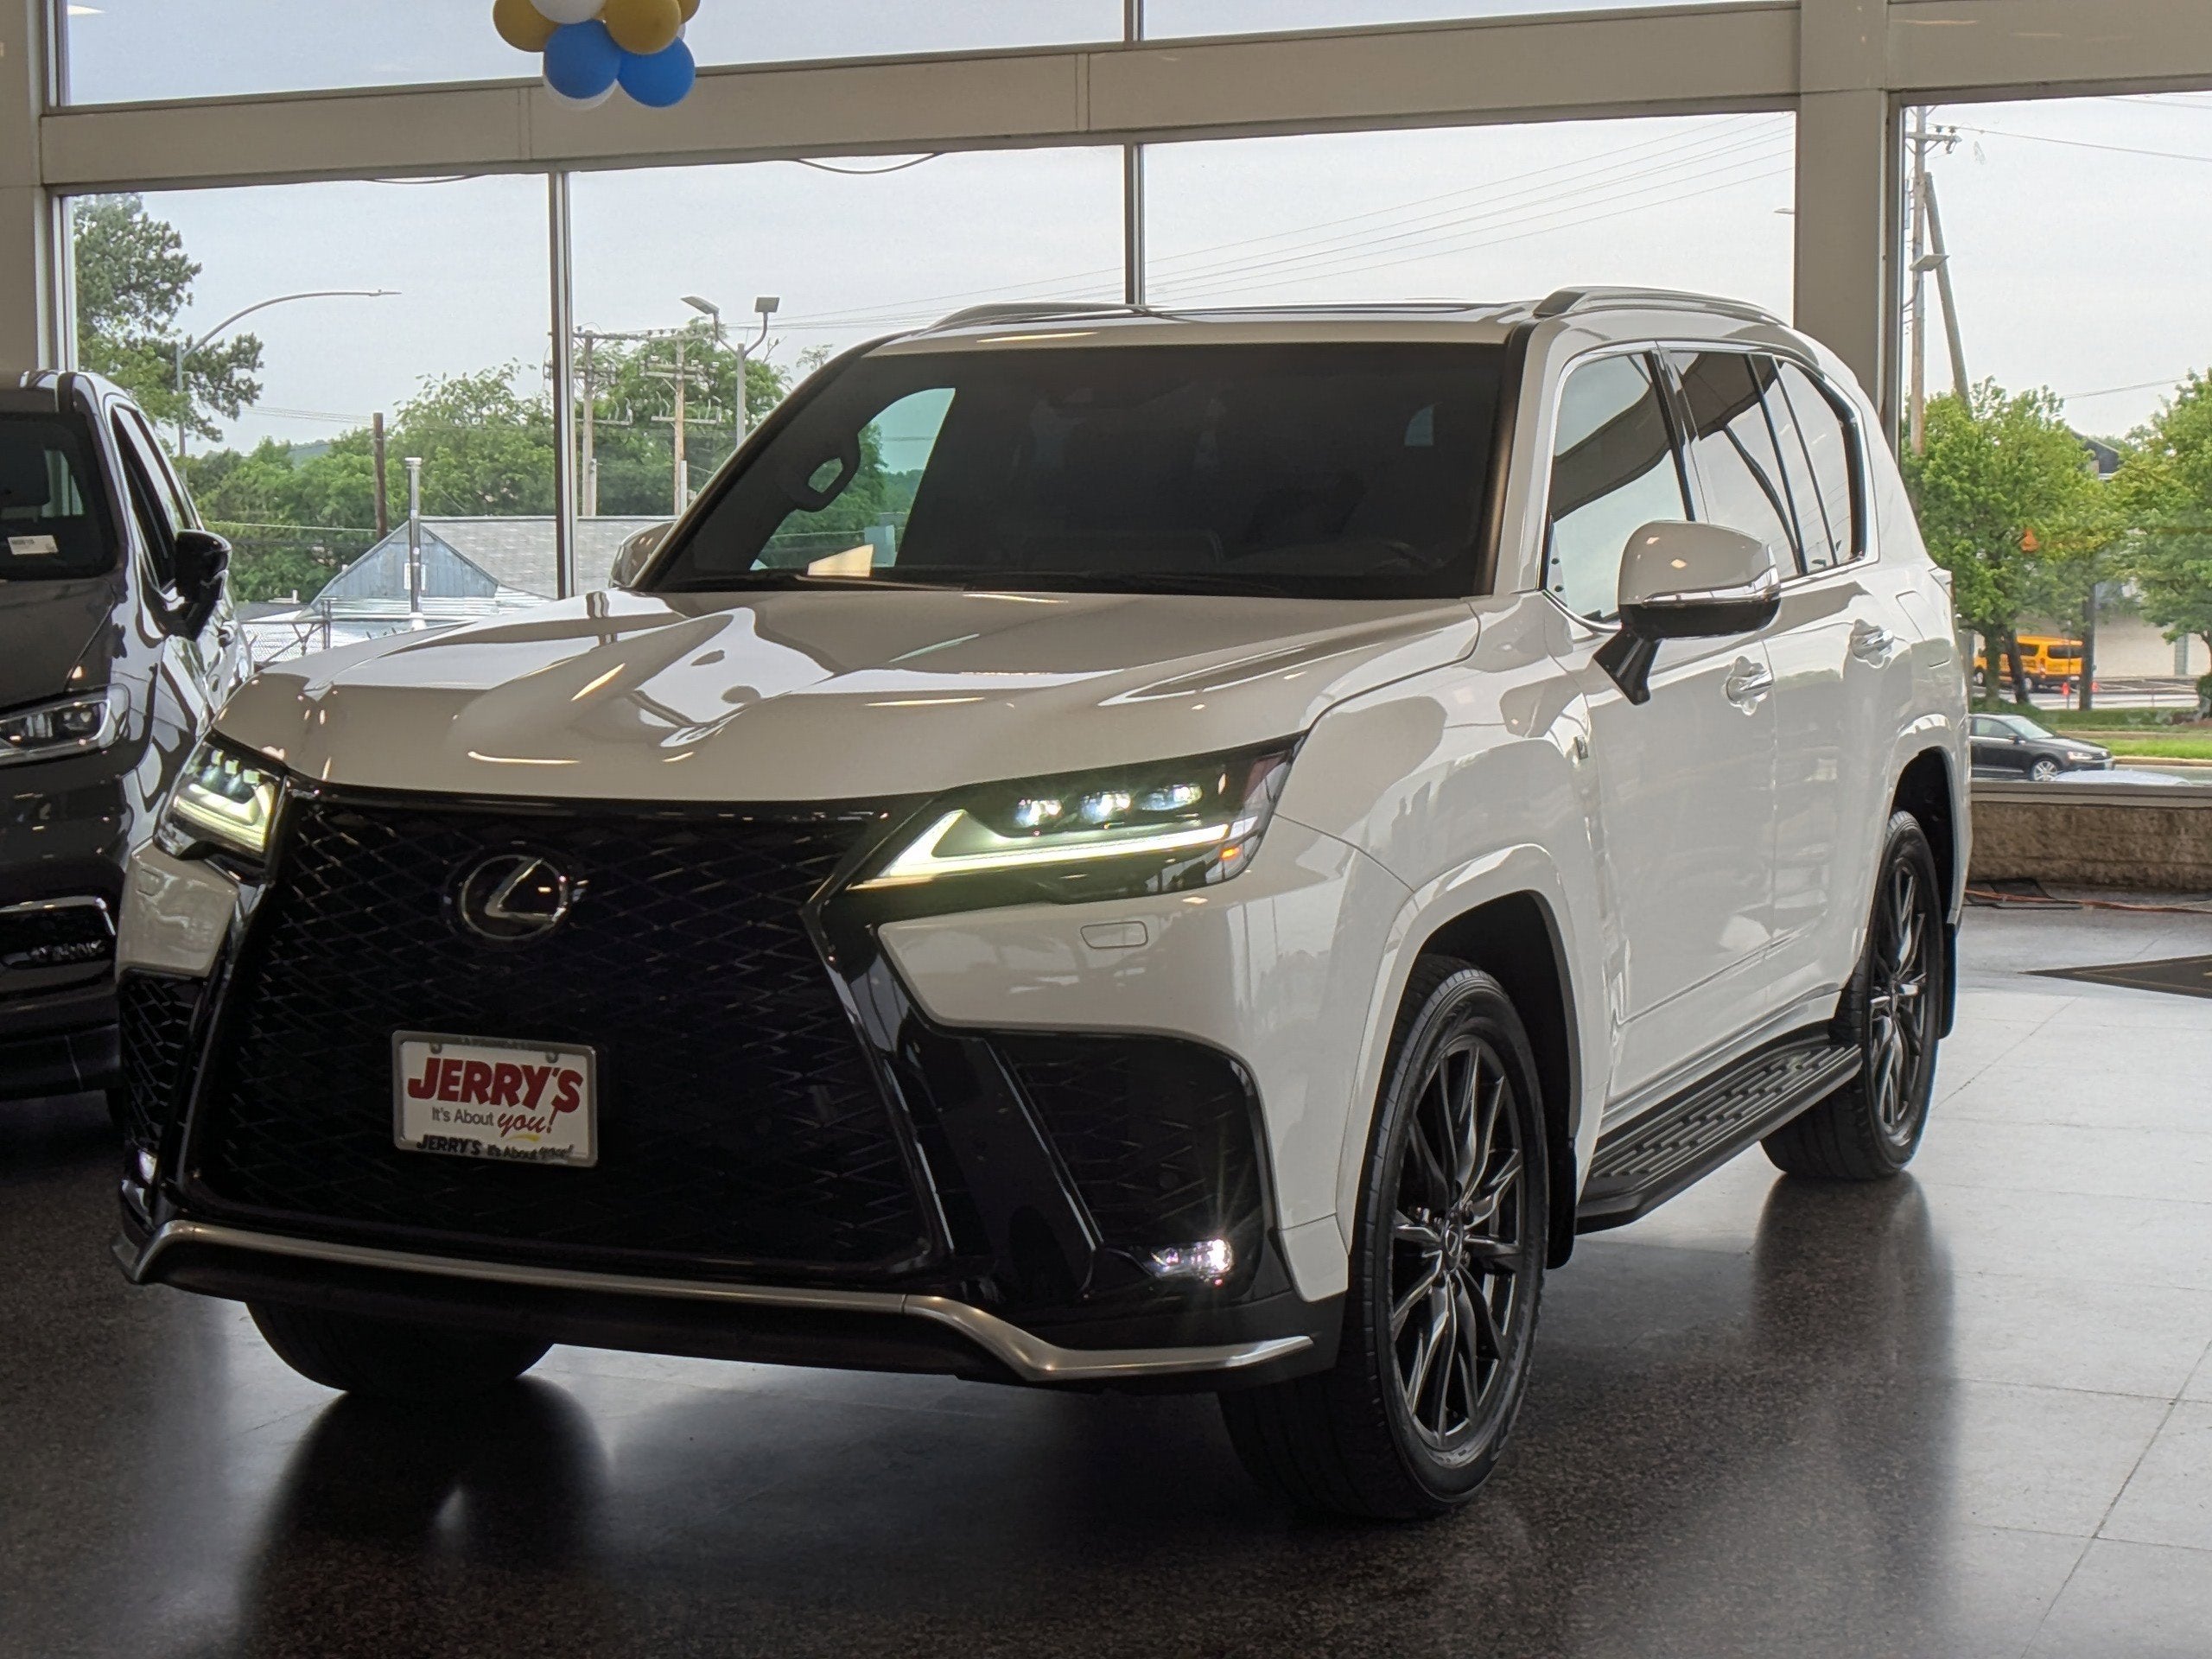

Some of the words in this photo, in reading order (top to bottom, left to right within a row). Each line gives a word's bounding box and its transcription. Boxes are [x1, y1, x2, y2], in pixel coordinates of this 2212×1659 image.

[407, 1057, 584, 1114] JERRY'S
[432, 1107, 451, 1122] It's
[454, 1109, 494, 1126] About
[497, 1108, 557, 1137] you!
[416, 1134, 483, 1156] JERRY'S
